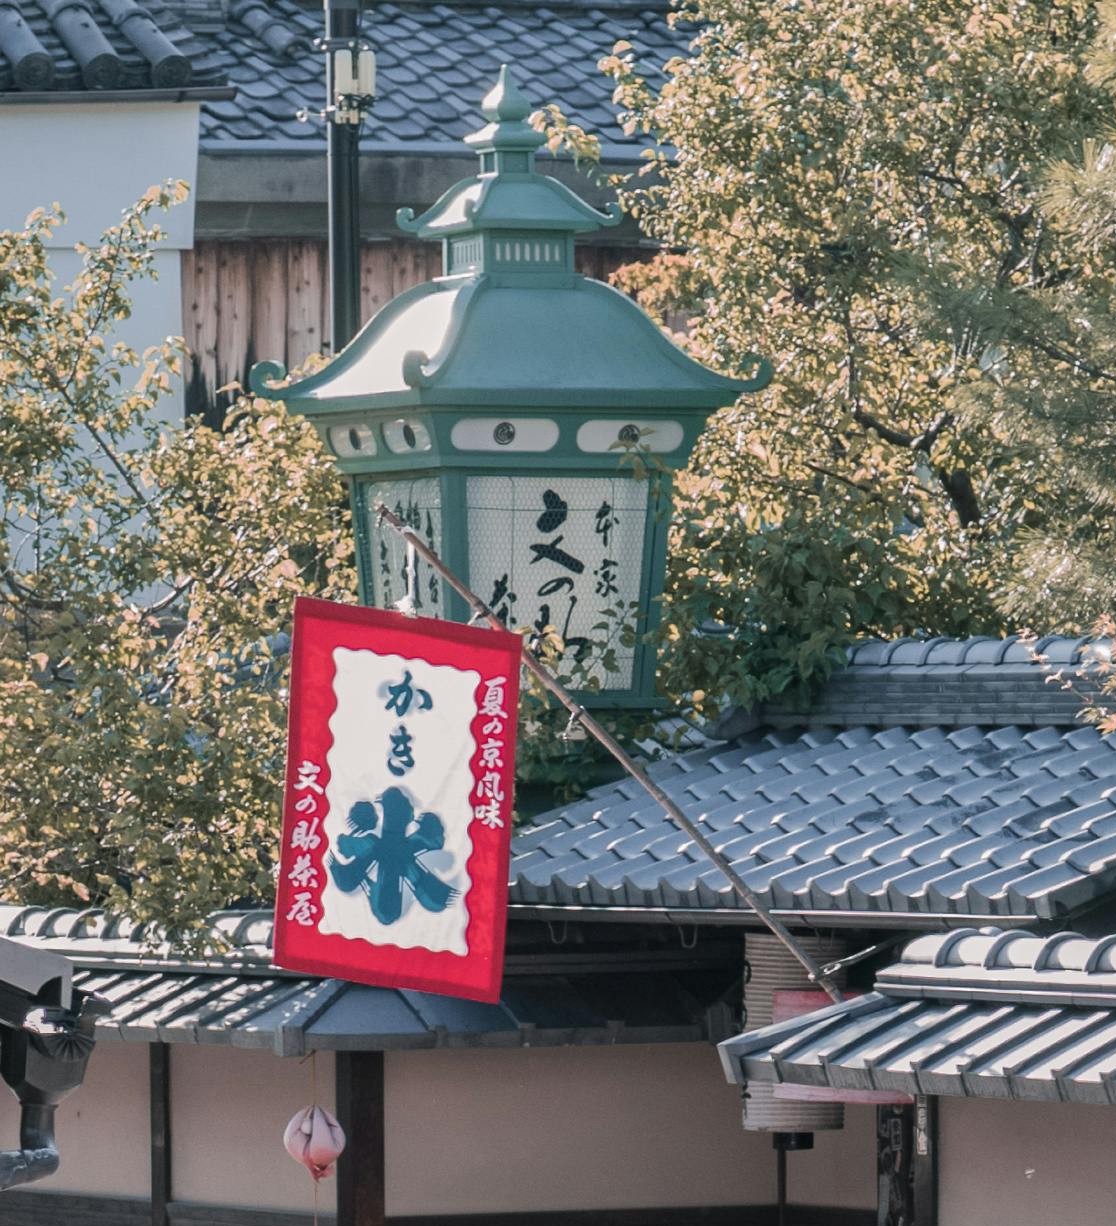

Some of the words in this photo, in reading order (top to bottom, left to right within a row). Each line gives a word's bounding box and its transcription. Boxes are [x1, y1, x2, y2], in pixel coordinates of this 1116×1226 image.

[474, 677, 508, 829] 夏の京風味
[287, 761, 324, 927] 文の助茶屋
